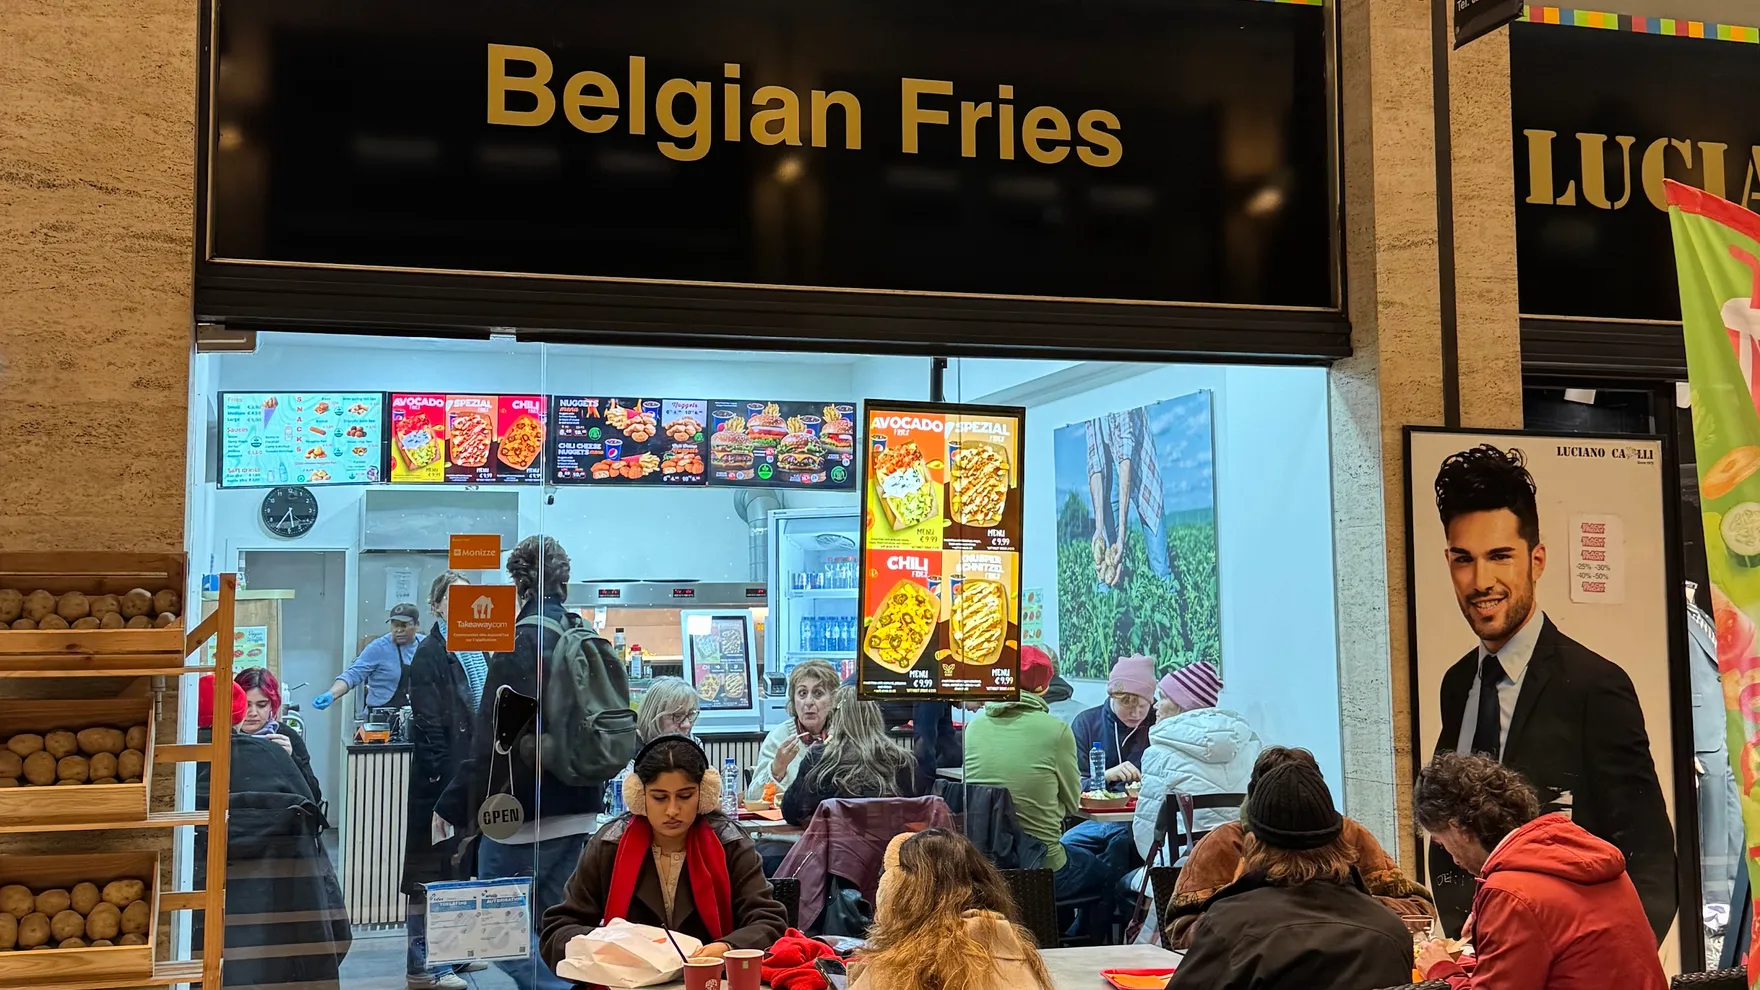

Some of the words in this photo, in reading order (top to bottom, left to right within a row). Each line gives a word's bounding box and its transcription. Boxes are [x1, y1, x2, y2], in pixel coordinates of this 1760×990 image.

[487, 43, 861, 161] Belgian
[901, 77, 1123, 167] Fries
[392, 397, 444, 407] AVOCADO
[453, 399, 492, 408] SPEZIAL
[511, 400, 539, 409] CHILI
[560, 399, 599, 407] NUGGETS
[871, 417, 943, 432] AVOCADO
[955, 422, 1010, 436] SPEZIAL
[1557, 446, 1605, 458] LUCIANO
[1612, 448, 1653, 459] CALLI
[987, 529, 1005, 537] MENU
[887, 556, 929, 571] CHILI
[909, 670, 928, 678] MENU
[992, 669, 1010, 677] MENU
[483, 808, 519, 825] OPEN
